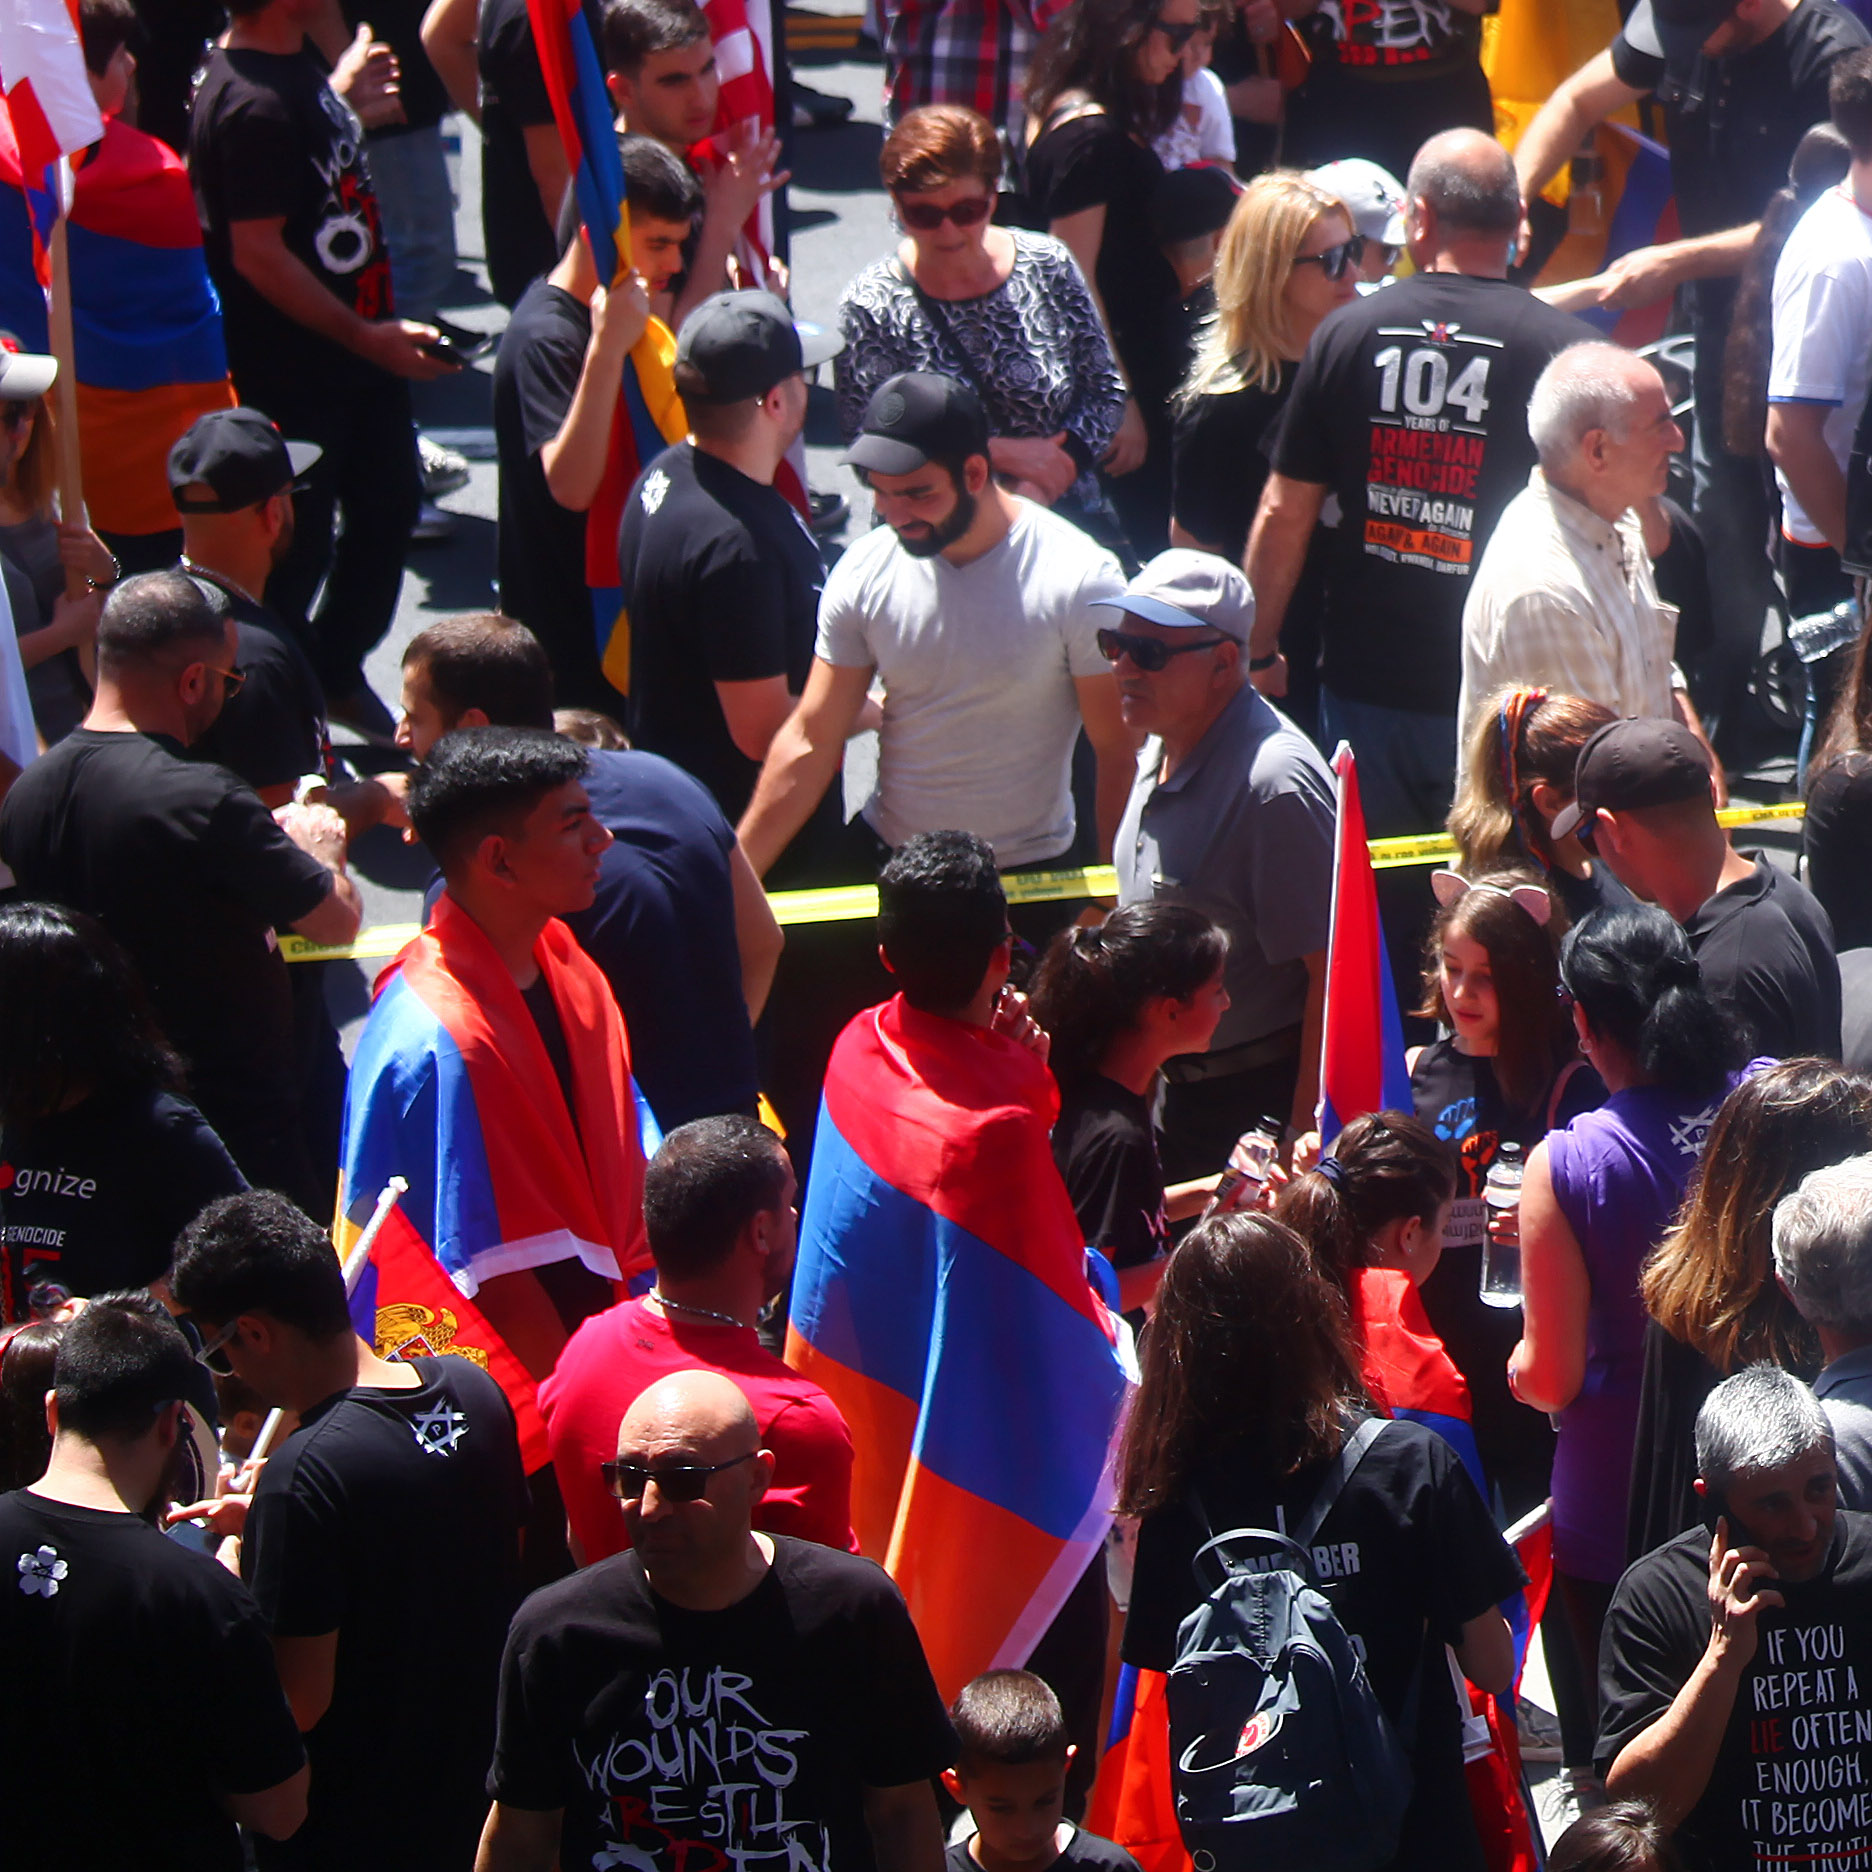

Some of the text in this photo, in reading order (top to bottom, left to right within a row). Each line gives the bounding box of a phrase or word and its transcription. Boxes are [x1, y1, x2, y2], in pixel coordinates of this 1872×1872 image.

[1374, 345, 1491, 423] 104
[1370, 426, 1487, 468] ARMENIAN
[1367, 457, 1481, 500] GENOCIDE
[1419, 500, 1475, 531] AGAIN
[1767, 1624, 1845, 1665] IF YOU
[645, 1666, 773, 1729] OUR
[1753, 1666, 1859, 1712] REPEAT A
[1751, 1709, 1872, 1754] LIE OFTEN
[572, 1717, 810, 1798] WOUNDS
[1756, 1752, 1870, 1795] ENOUGH,
[1741, 1799, 1763, 1832] IT
[1753, 1839, 1799, 1872] THE
